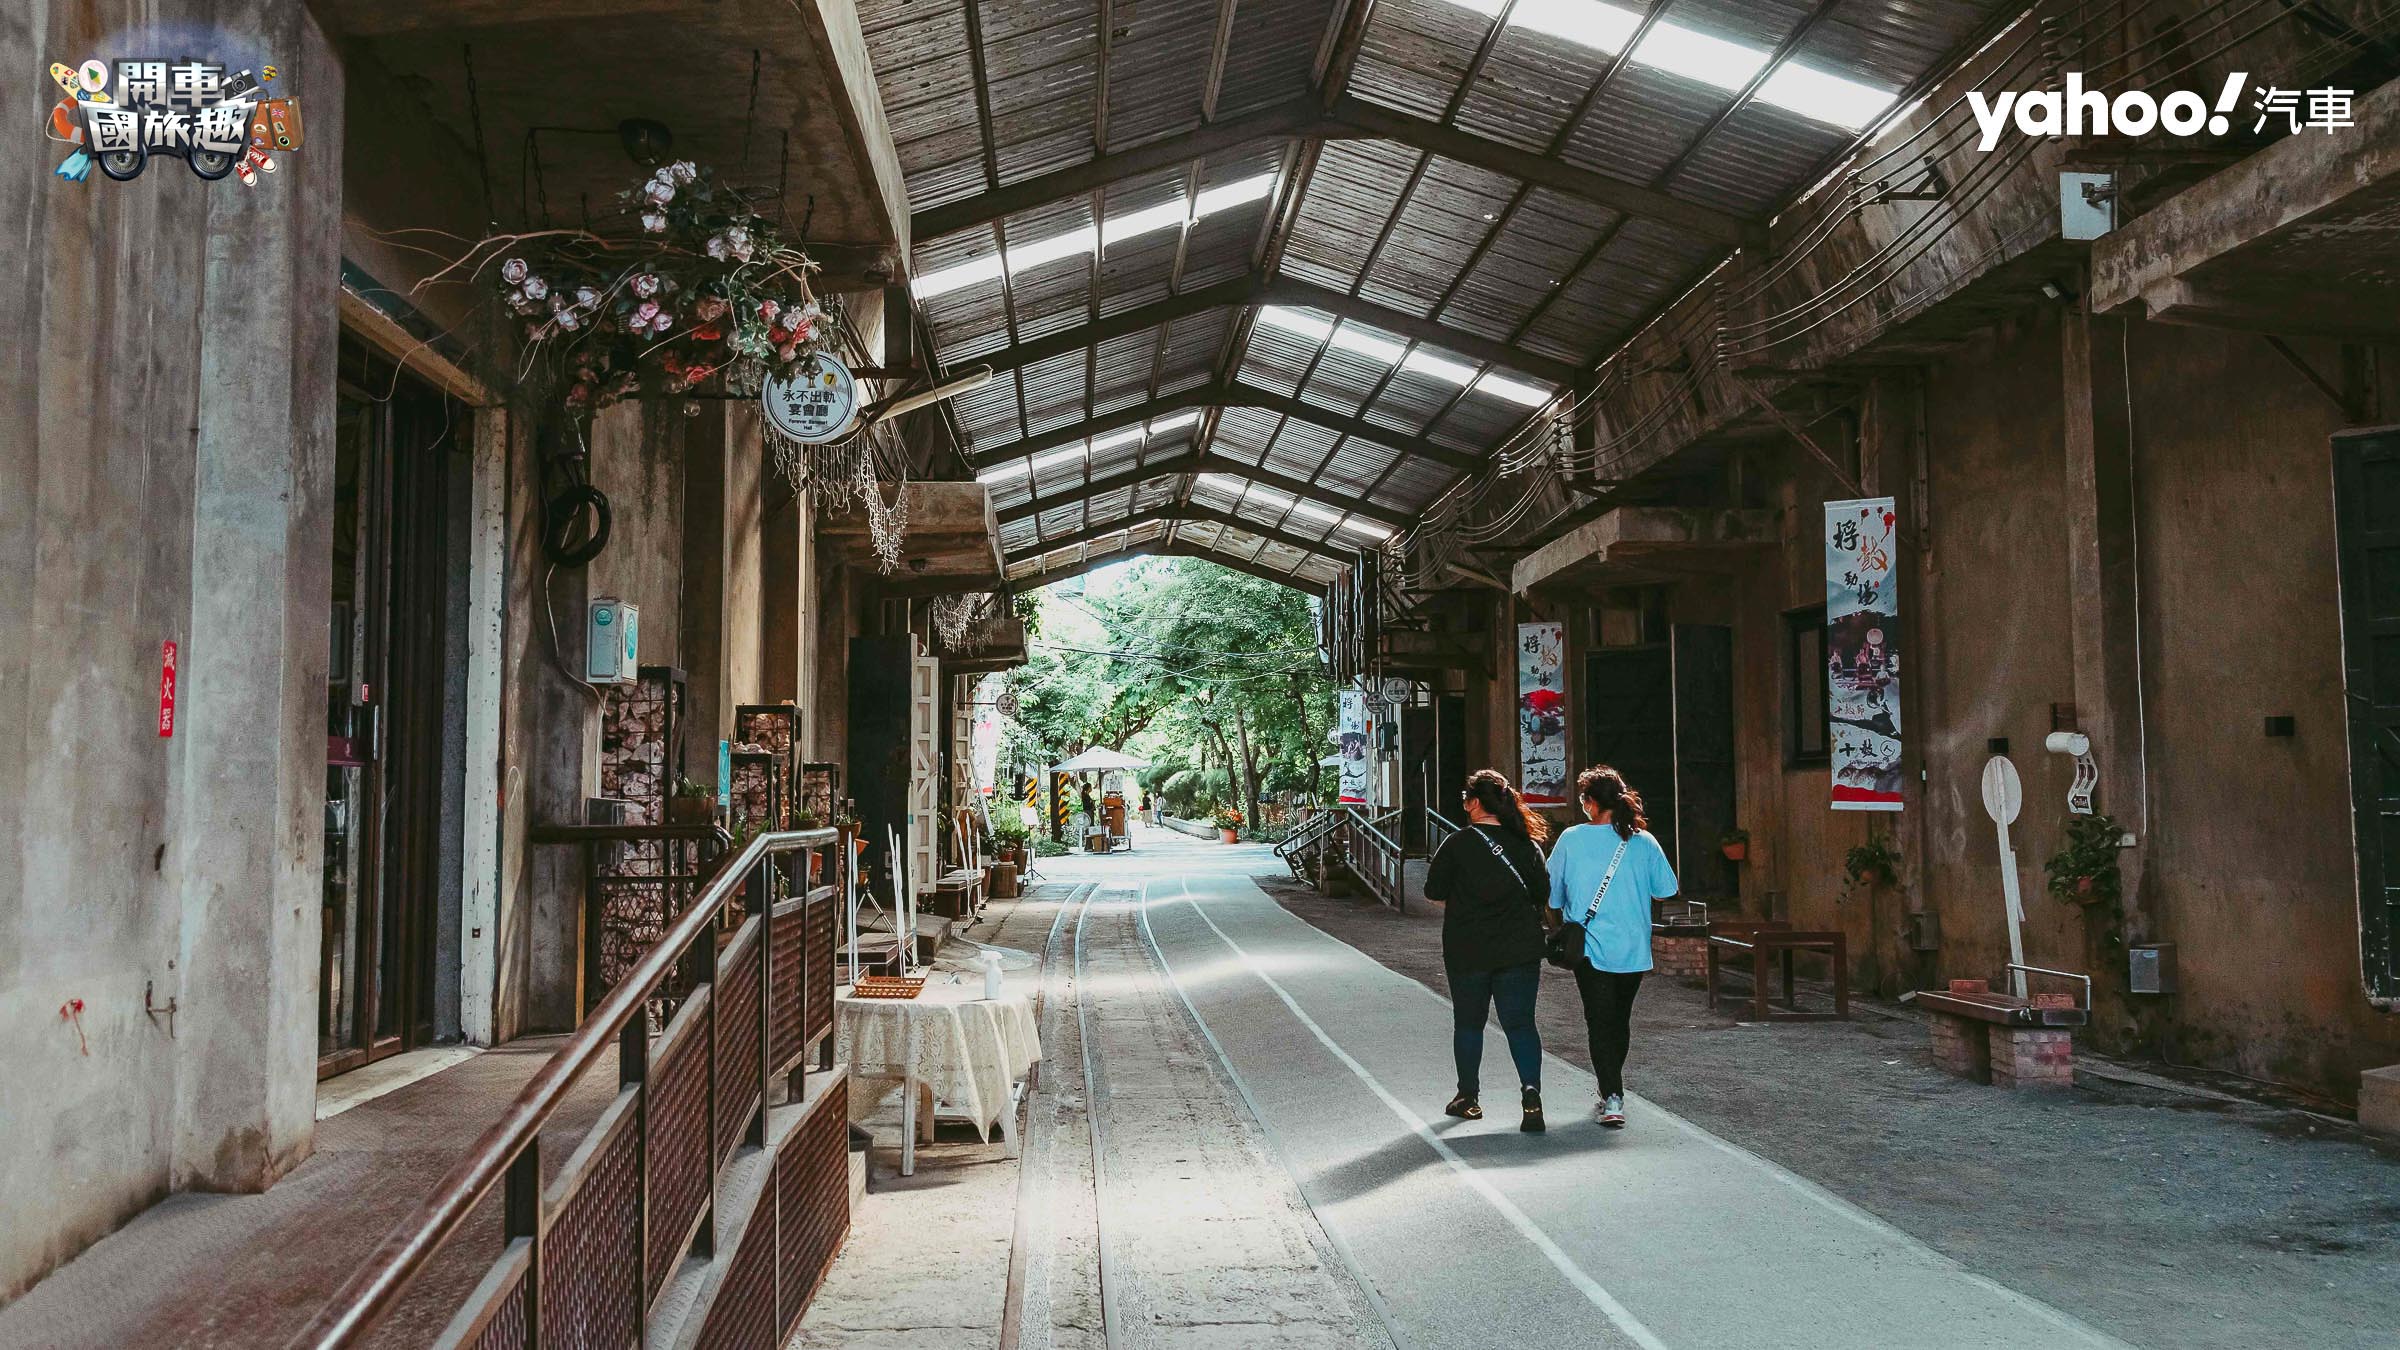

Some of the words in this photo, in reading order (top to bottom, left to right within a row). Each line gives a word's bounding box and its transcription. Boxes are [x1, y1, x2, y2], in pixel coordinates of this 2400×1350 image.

[827, 374, 835, 384] 7
[783, 389, 836, 403] 永不出軌
[788, 404, 828, 416] 宴會廳
[162, 646, 175, 730] 滅火器
